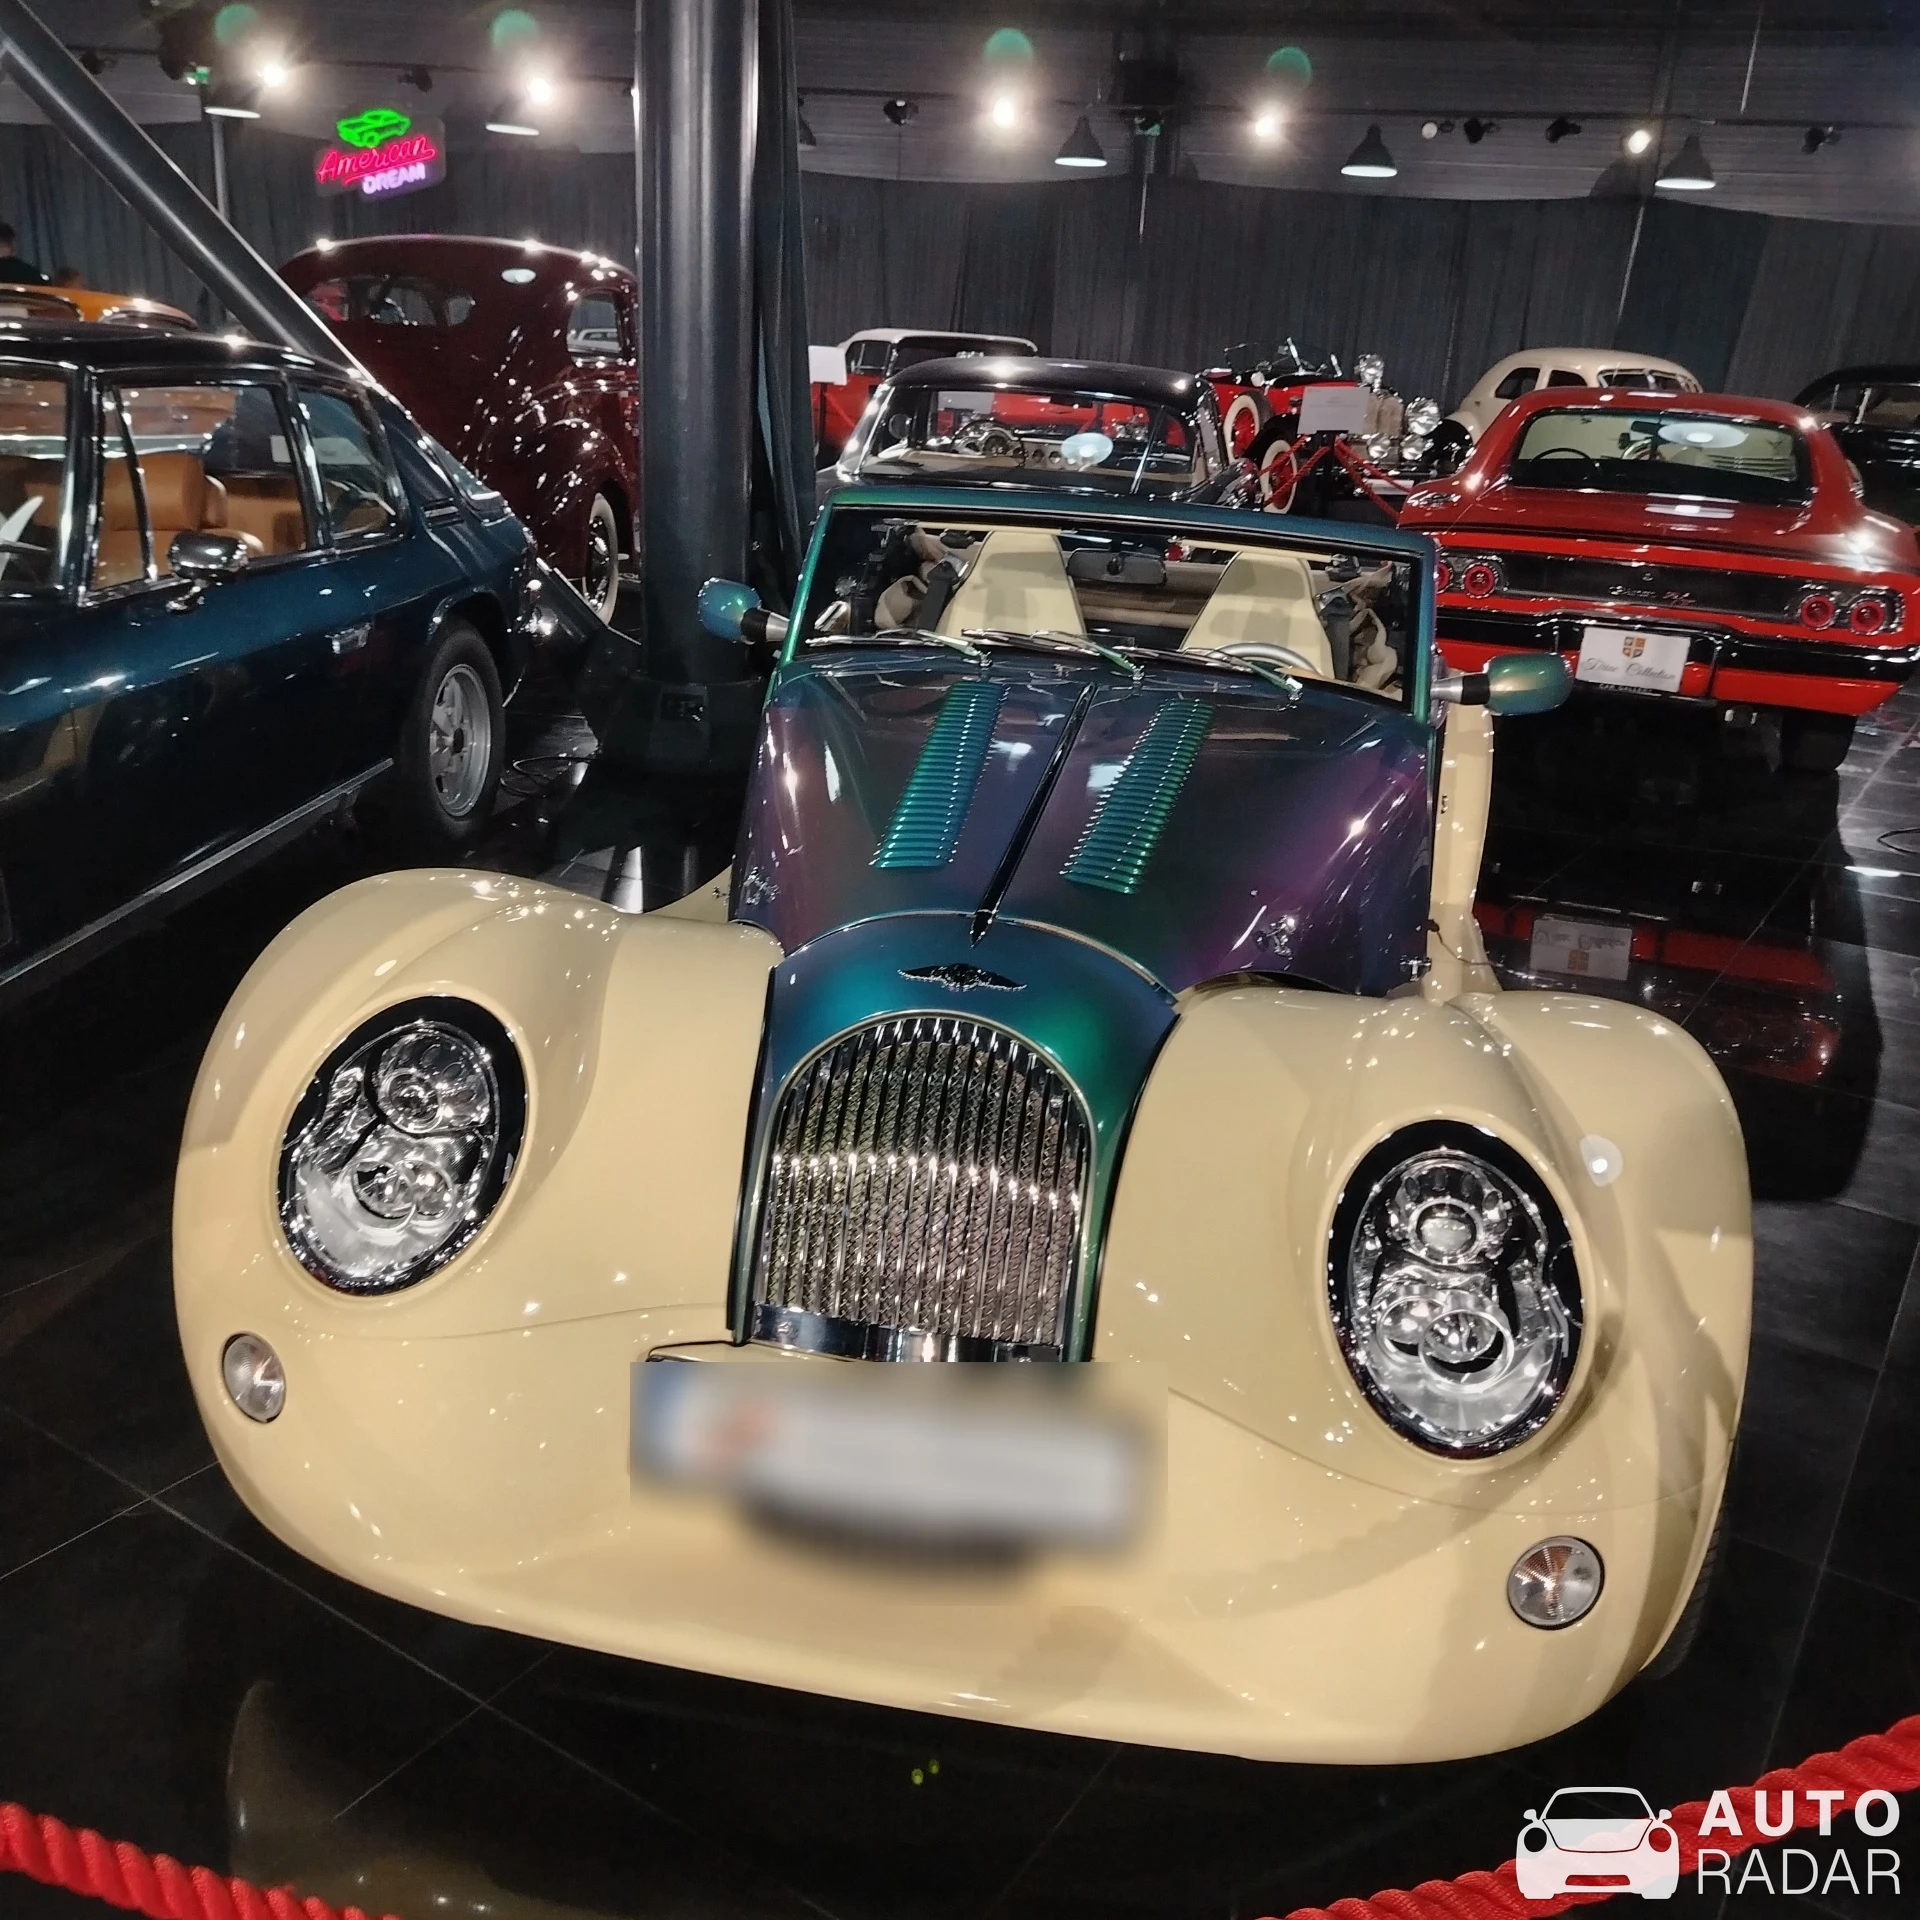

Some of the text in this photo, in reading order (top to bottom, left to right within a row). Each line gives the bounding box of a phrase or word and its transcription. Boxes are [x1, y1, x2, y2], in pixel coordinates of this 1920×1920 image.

[317, 135, 437, 184] American
[362, 162, 426, 194] DREAM
[1625, 662, 1676, 680] Collection
